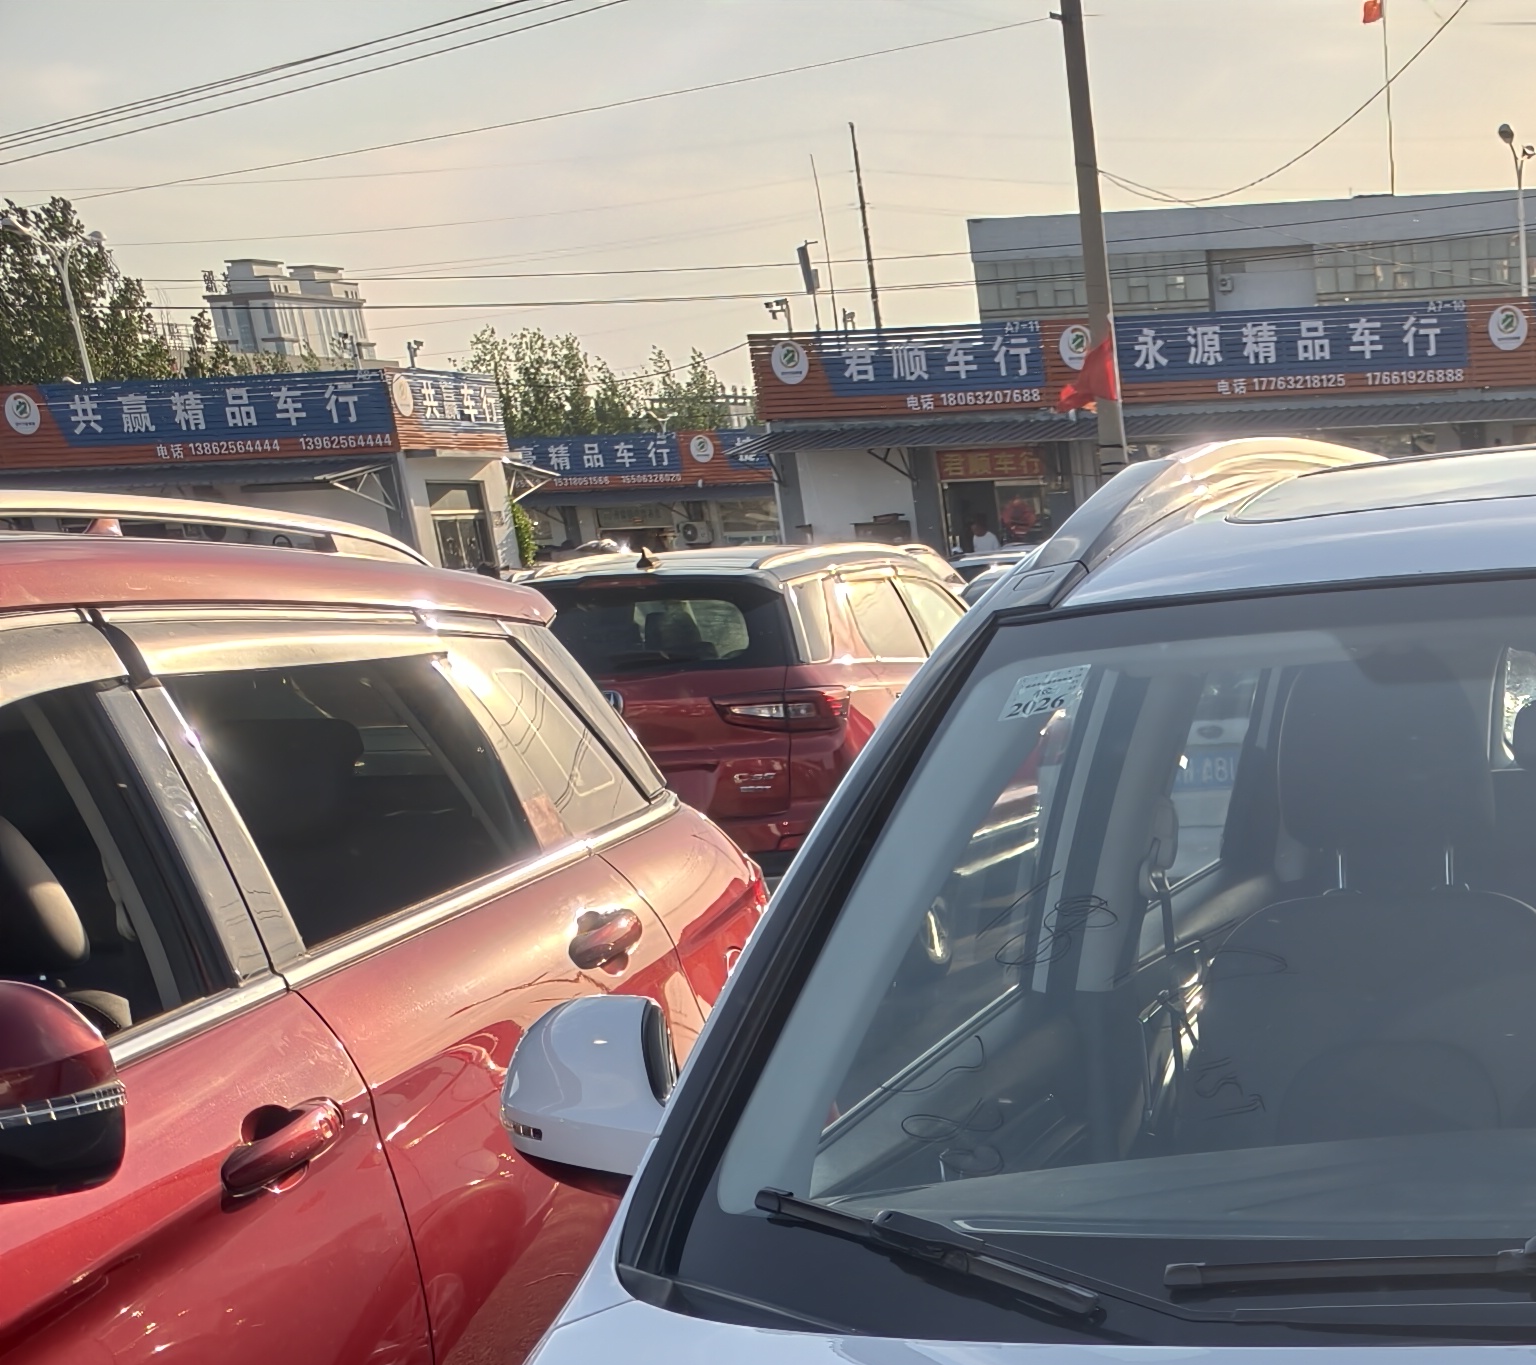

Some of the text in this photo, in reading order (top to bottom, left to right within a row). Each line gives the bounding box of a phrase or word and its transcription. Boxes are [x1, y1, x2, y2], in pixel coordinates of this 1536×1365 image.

[1133, 316, 1441, 370] 永源精品车行
[842, 336, 1032, 382] 君顺车行
[1216, 368, 1465, 395] 电话 17763218125 17661926888
[69, 383, 359, 435] 共赢精品车行
[906, 388, 1041, 411] 电话 18063207688
[156, 434, 393, 460] 电话 13862564444 13962564444
[1004, 692, 1067, 718] 2026
